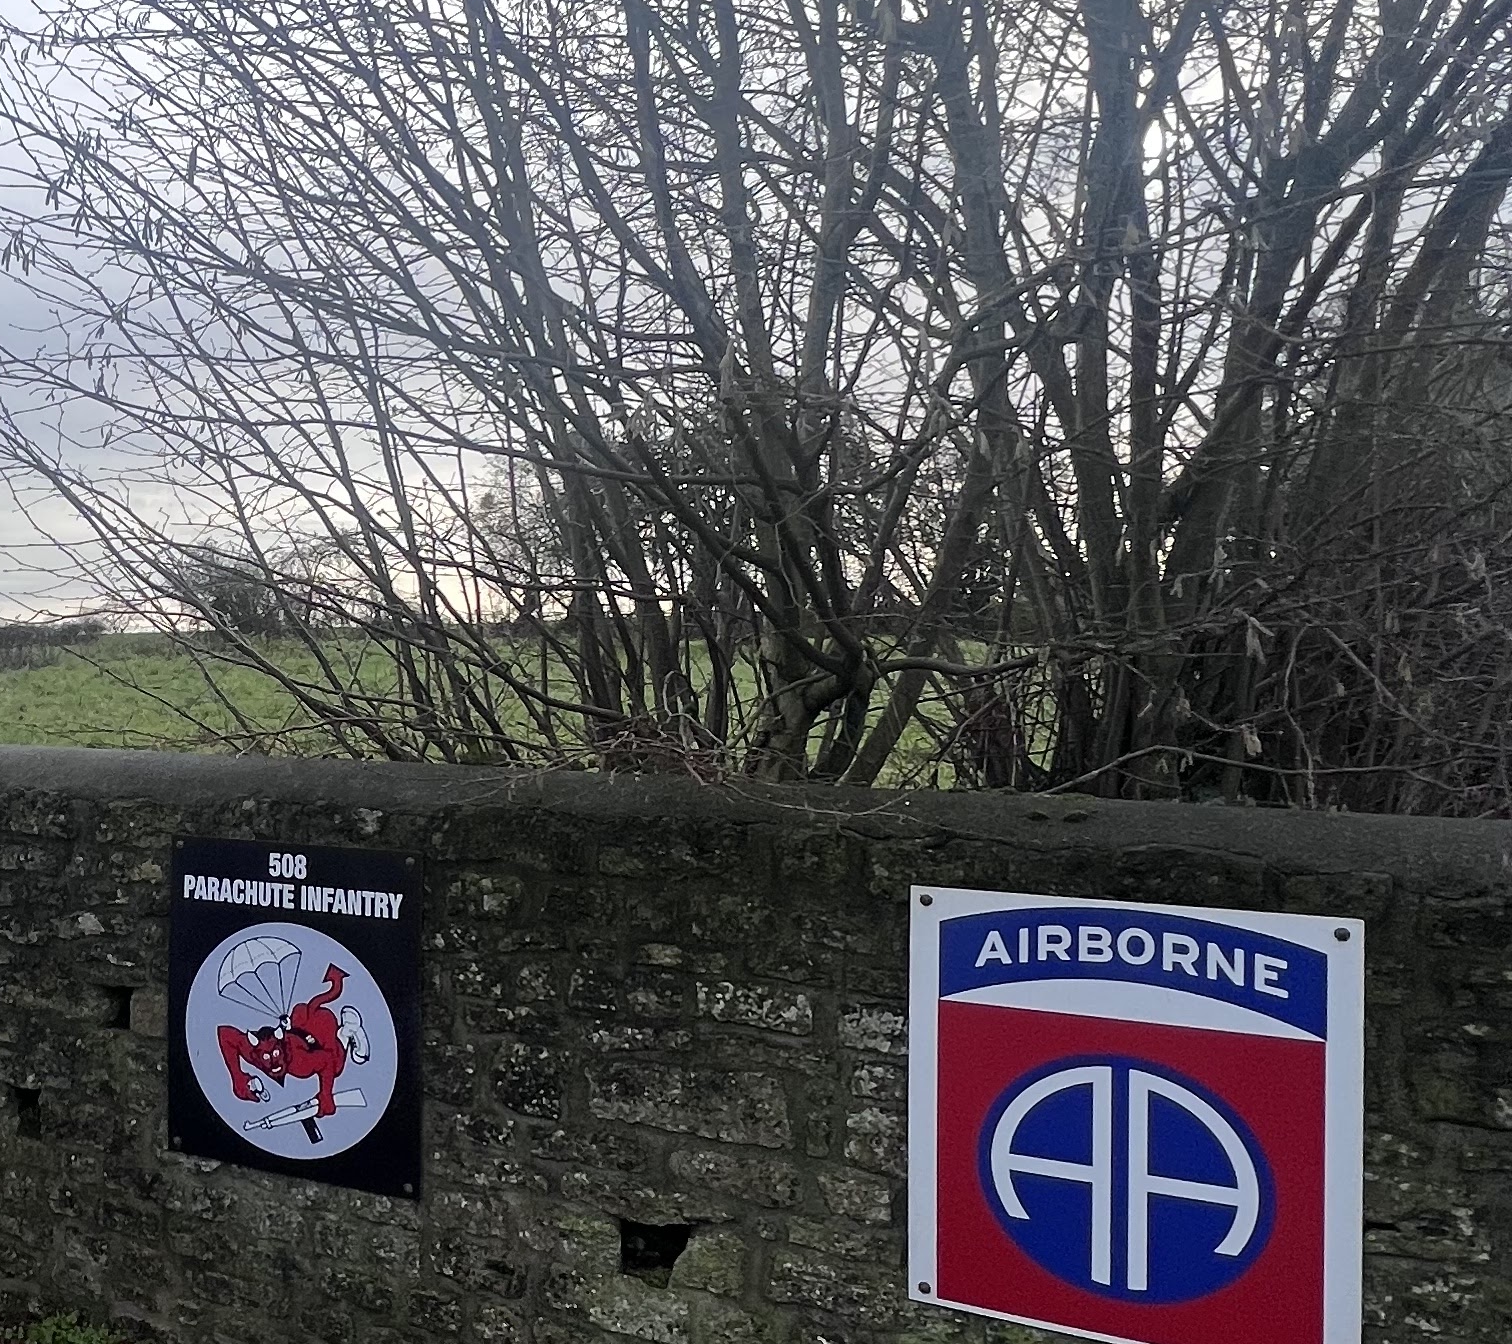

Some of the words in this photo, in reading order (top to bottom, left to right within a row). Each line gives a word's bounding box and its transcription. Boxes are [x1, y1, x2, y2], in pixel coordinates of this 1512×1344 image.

[268, 852, 307, 879] 508
[183, 874, 295, 909] PARACHUTE
[300, 885, 403, 919] INFANTRY
[974, 924, 1289, 999] AIRBORNE
[990, 1065, 1260, 1291] AA
